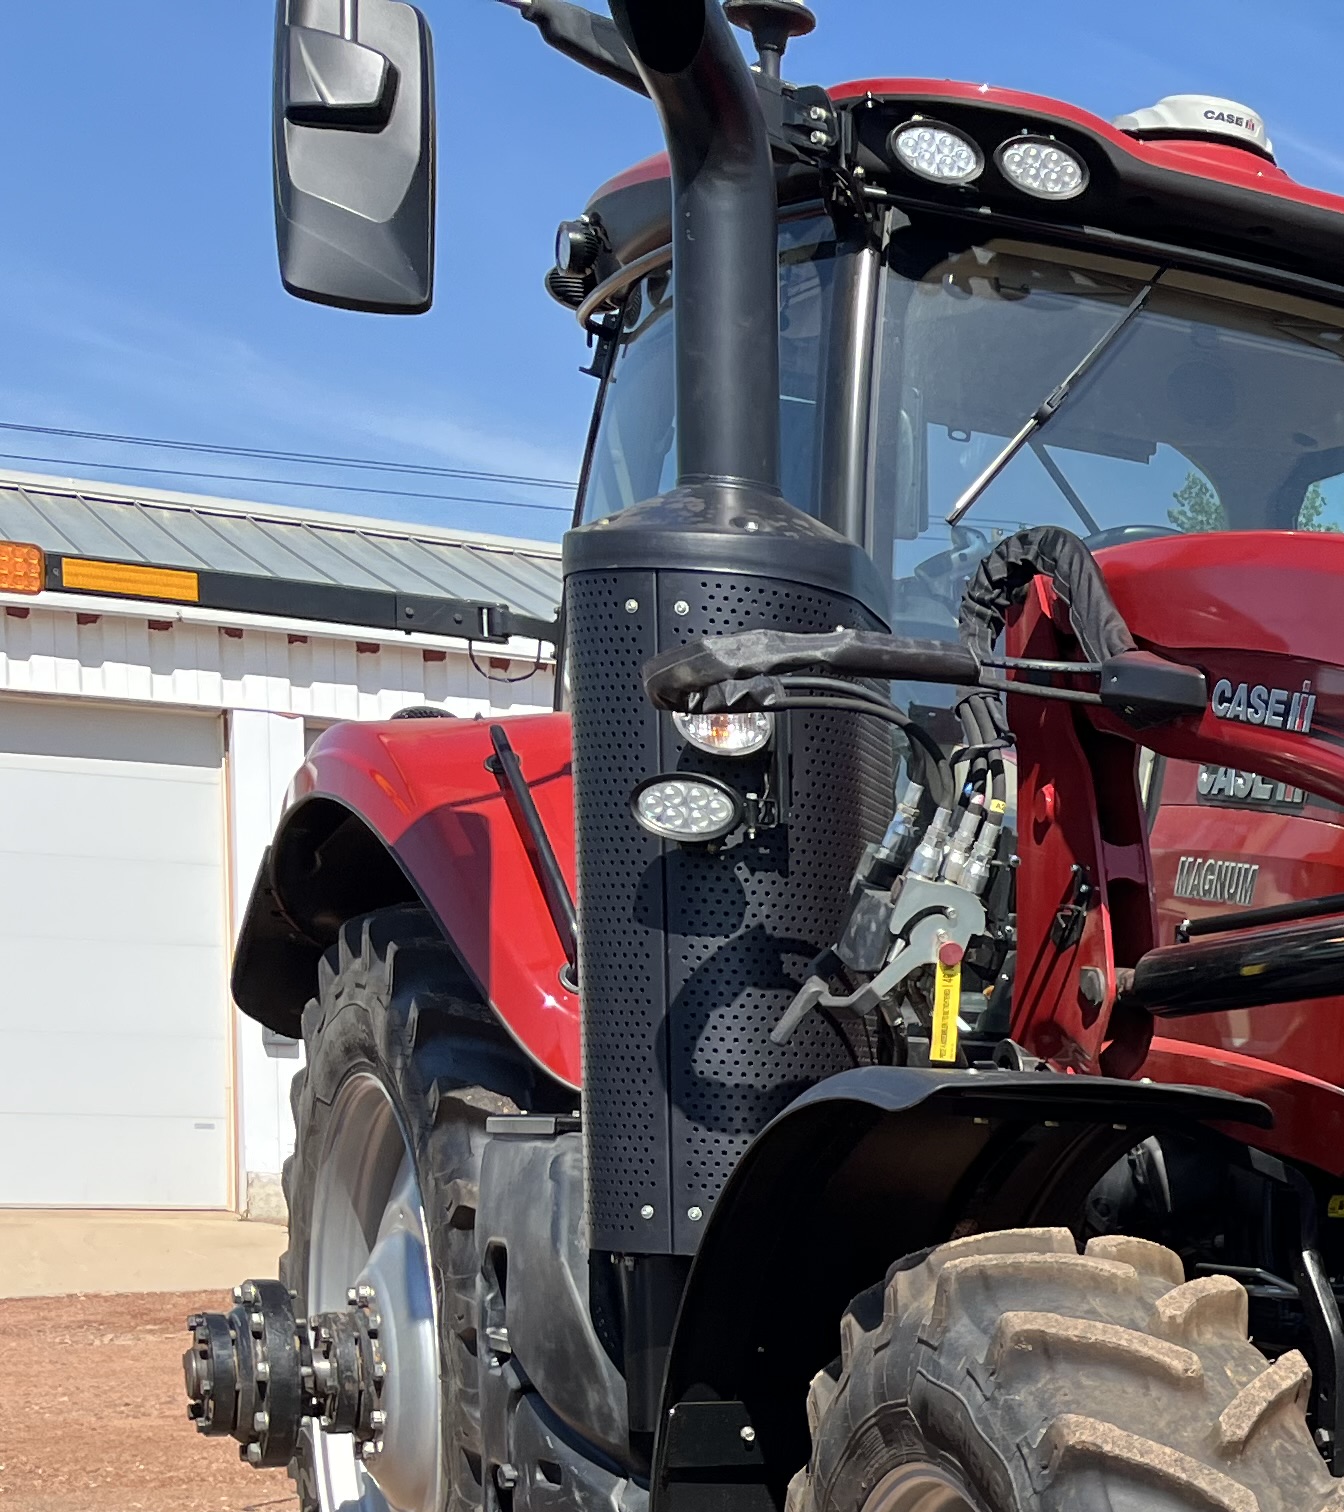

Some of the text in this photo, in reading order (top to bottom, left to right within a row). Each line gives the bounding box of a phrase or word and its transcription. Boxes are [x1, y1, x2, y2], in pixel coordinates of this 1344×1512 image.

[1203, 109, 1244, 127] CASE
[1211, 678, 1289, 728] CASE
[1173, 856, 1260, 905] MAGNUM
